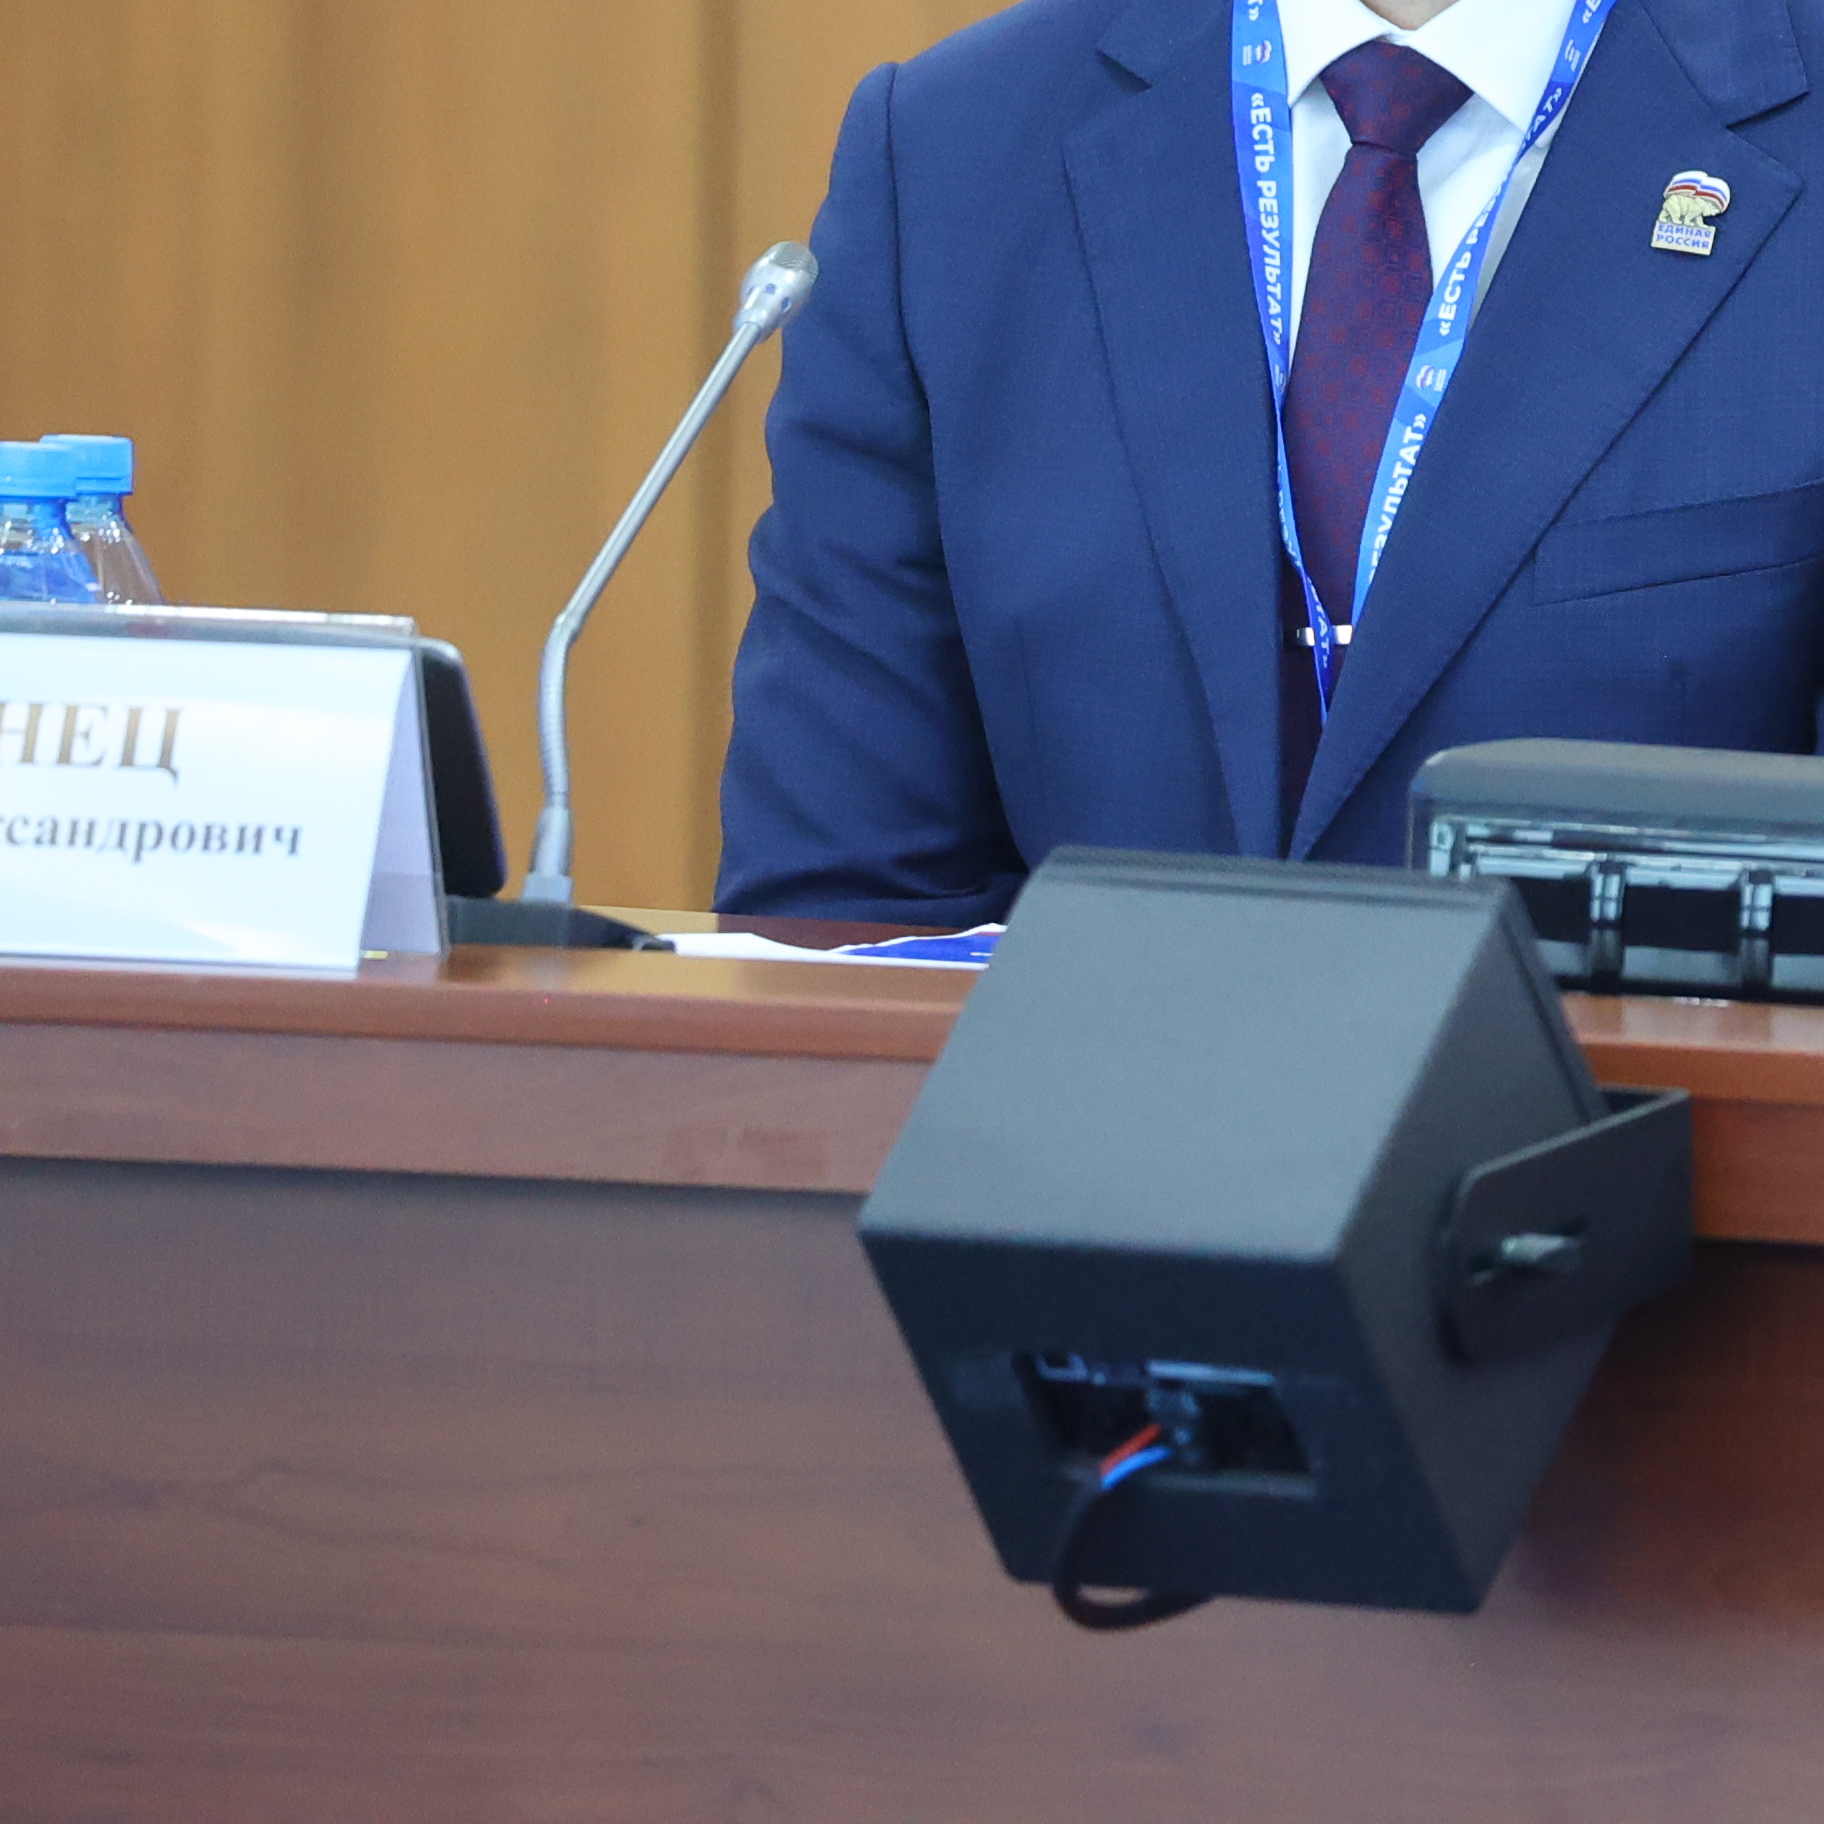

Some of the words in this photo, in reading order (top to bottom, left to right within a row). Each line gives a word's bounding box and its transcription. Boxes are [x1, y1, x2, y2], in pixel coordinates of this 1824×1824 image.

[1250, 92, 1276, 173] «ЕСТЬ
[1256, 179, 1283, 345] РЕЗУЛЬТАТ»
[1656, 233, 1710, 249] РОССИЯ
[1658, 224, 1712, 238] ЕДИНАЯ
[1438, 251, 1473, 336] «ЕСТЬ
[0, 813, 303, 864] сандрович
